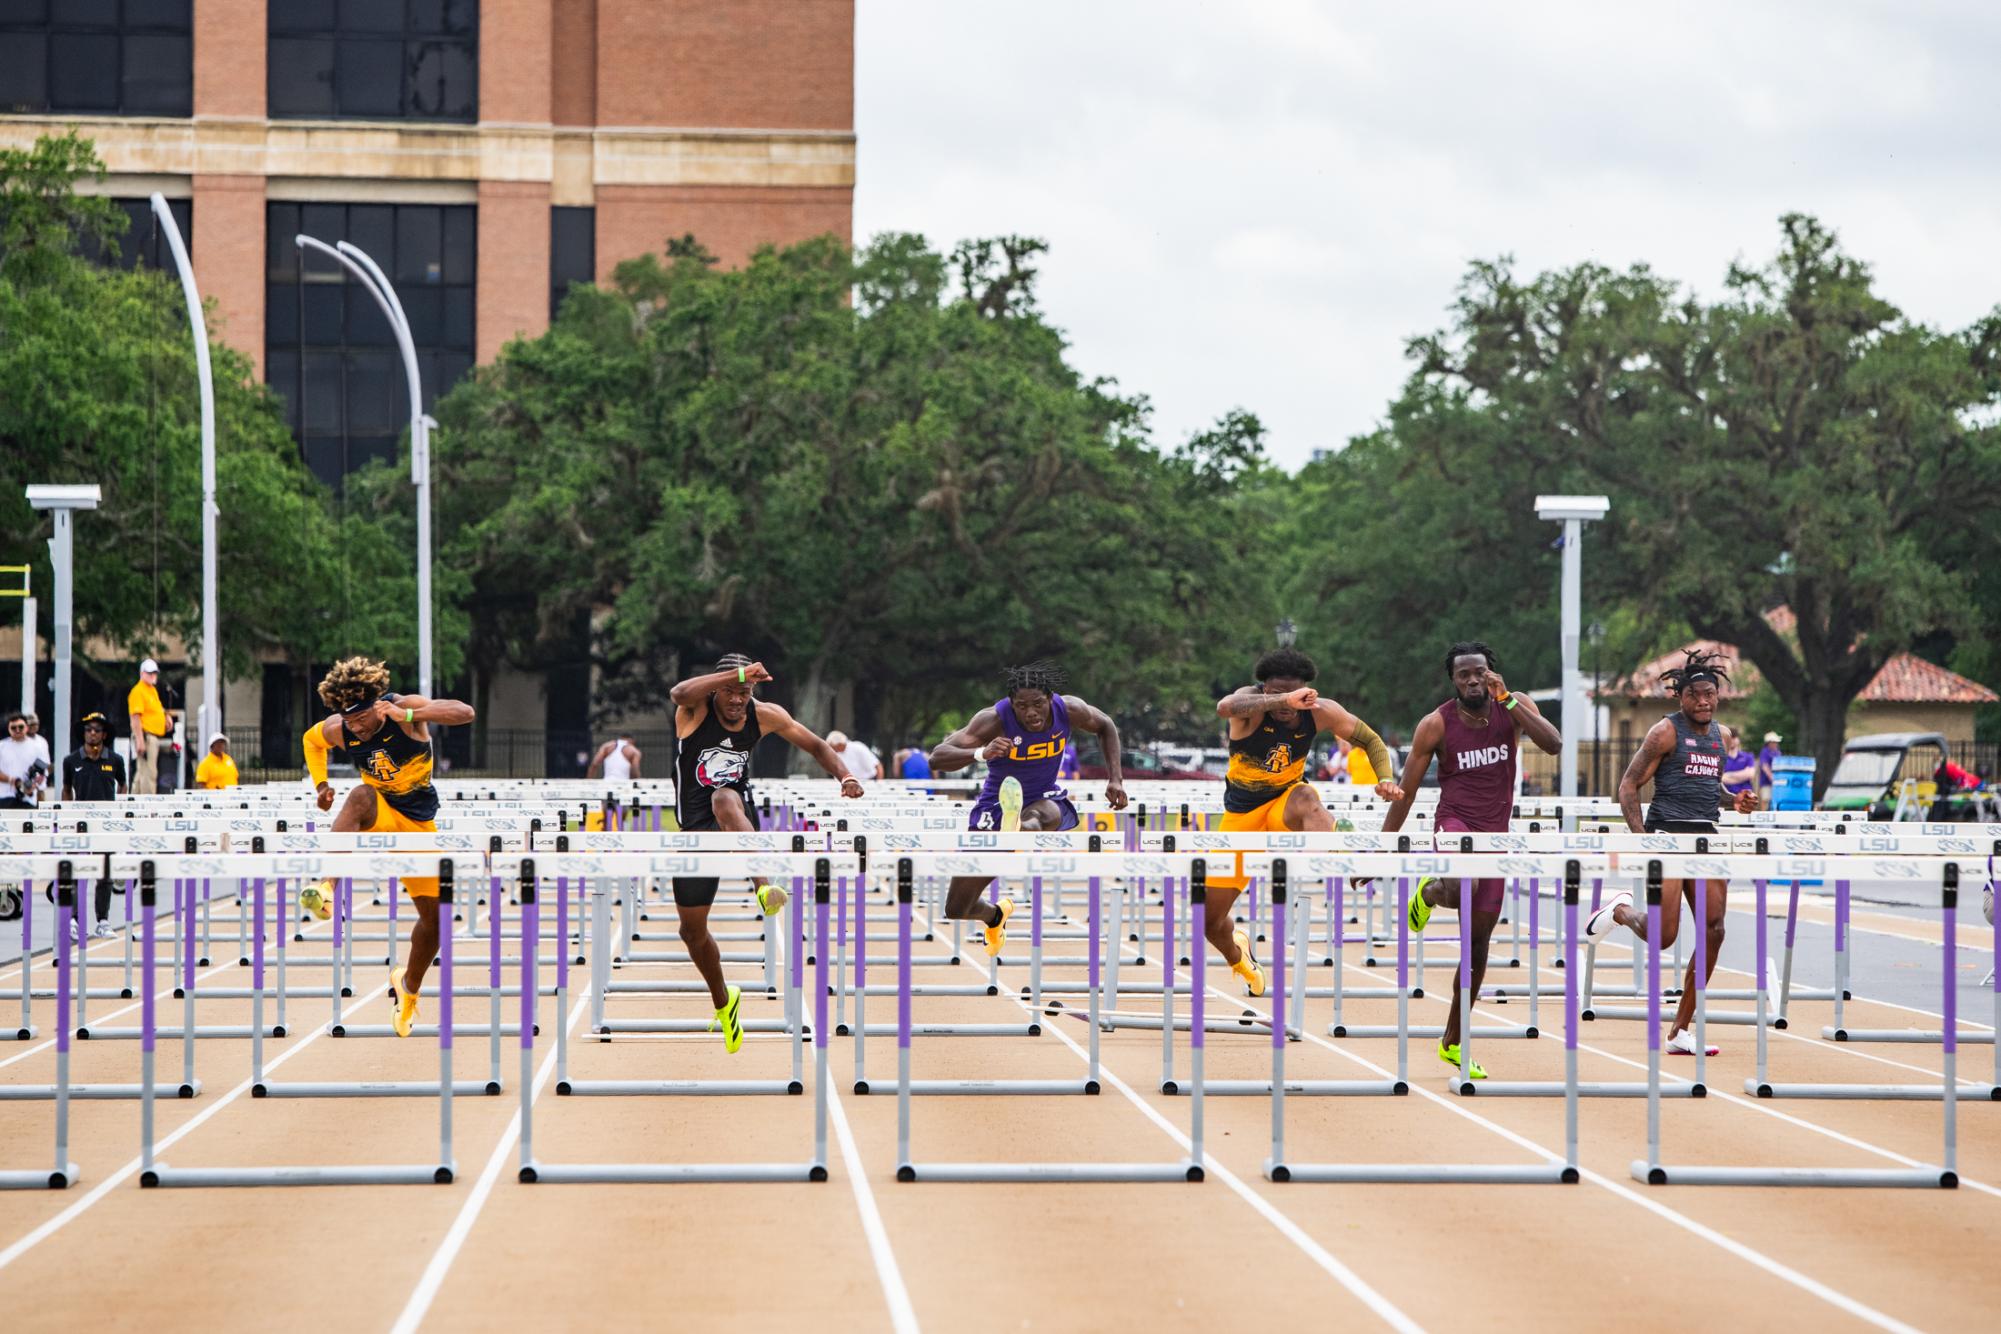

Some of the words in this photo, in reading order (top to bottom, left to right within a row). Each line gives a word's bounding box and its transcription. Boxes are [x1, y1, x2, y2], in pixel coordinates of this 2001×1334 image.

[1009, 737, 1066, 760] LSU
[1457, 744, 1509, 770] HINDS
[165, 821, 199, 832] LSU
[924, 819, 957, 831] LSU
[1922, 825, 1956, 836] LSU
[50, 836, 90, 849] LSU
[357, 836, 397, 848] LSU
[661, 835, 700, 848] LSU
[958, 835, 998, 848] LSU
[1267, 836, 1307, 848] LSU
[1564, 837, 1604, 849] LSU
[1860, 838, 1900, 851] LSU
[272, 858, 322, 874] LSU
[650, 857, 700, 873] LSU
[1027, 857, 1076, 873] LSU
[1402, 858, 1450, 874] LSU
[1778, 860, 1826, 876] LSU
